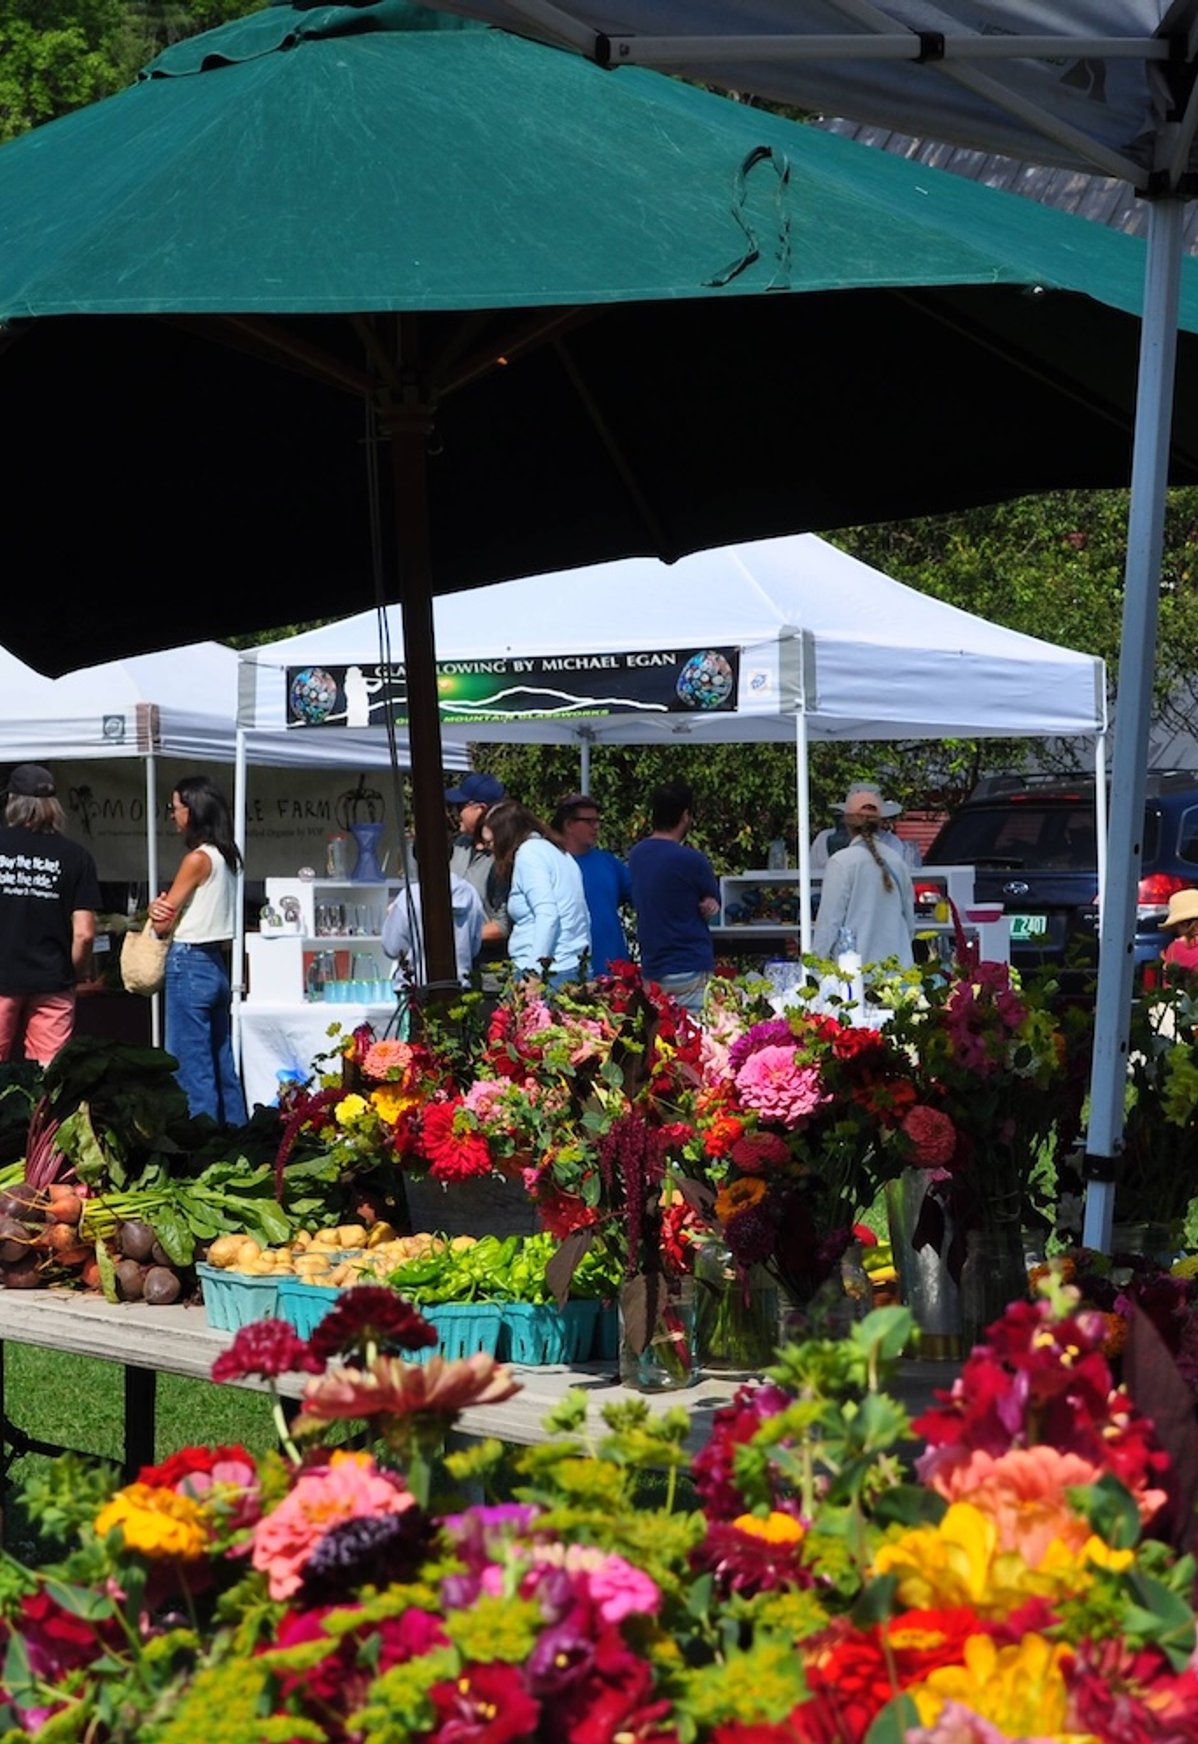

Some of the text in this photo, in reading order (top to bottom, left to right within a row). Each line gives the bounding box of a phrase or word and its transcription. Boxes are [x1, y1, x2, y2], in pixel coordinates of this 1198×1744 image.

[513, 660, 534, 672] BY
[542, 655, 620, 671] MICHAEL
[627, 653, 677, 667] EGAN
[276, 798, 330, 821] FARM
